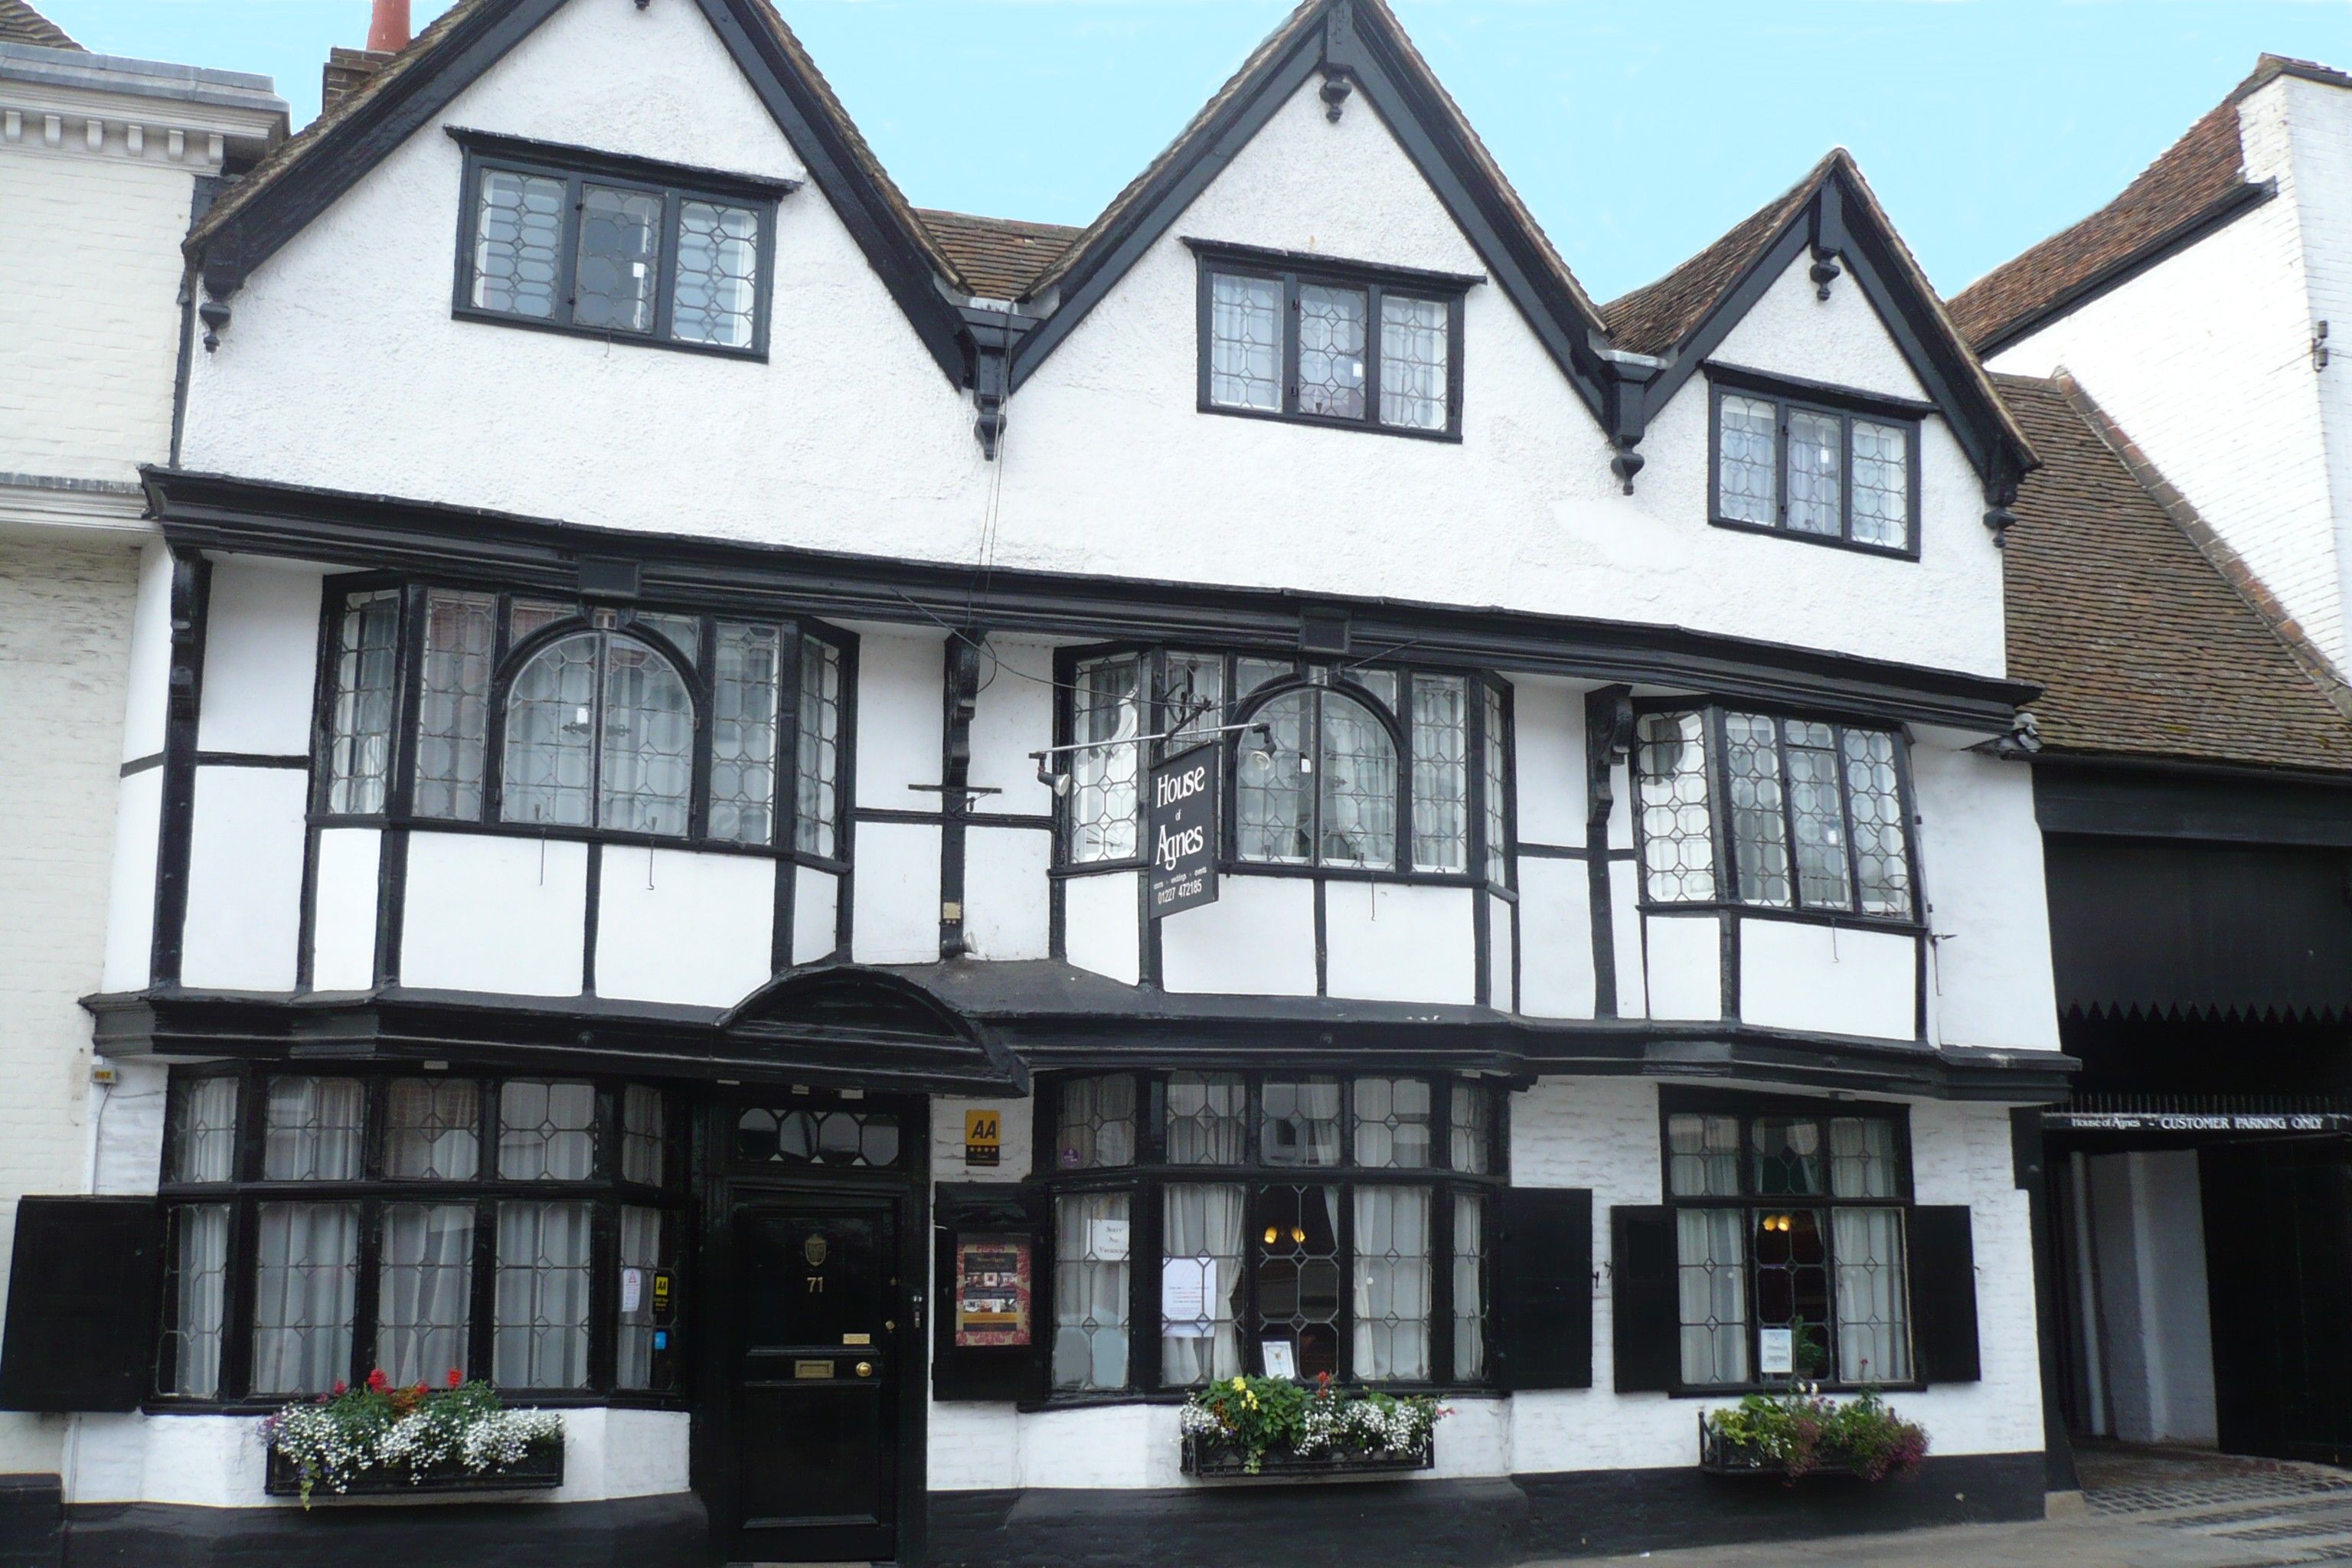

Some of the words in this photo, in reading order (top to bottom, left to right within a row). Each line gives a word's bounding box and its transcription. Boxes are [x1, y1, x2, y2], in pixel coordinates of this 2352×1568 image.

[1156, 766, 1205, 808] House
[1175, 808, 1182, 822] of
[1155, 824, 1204, 871] Agnes
[1158, 887, 1176, 905] 01227
[1178, 878, 1202, 897] 472185
[971, 1119, 997, 1140] AA
[2072, 1118, 2101, 1127] House
[2112, 1117, 2141, 1129] Agnes
[2161, 1117, 2230, 1129] CUSTOMER
[2233, 1117, 2287, 1129] PARKING
[2291, 1116, 2324, 1129] ONLY
[807, 1277, 823, 1292] 71
